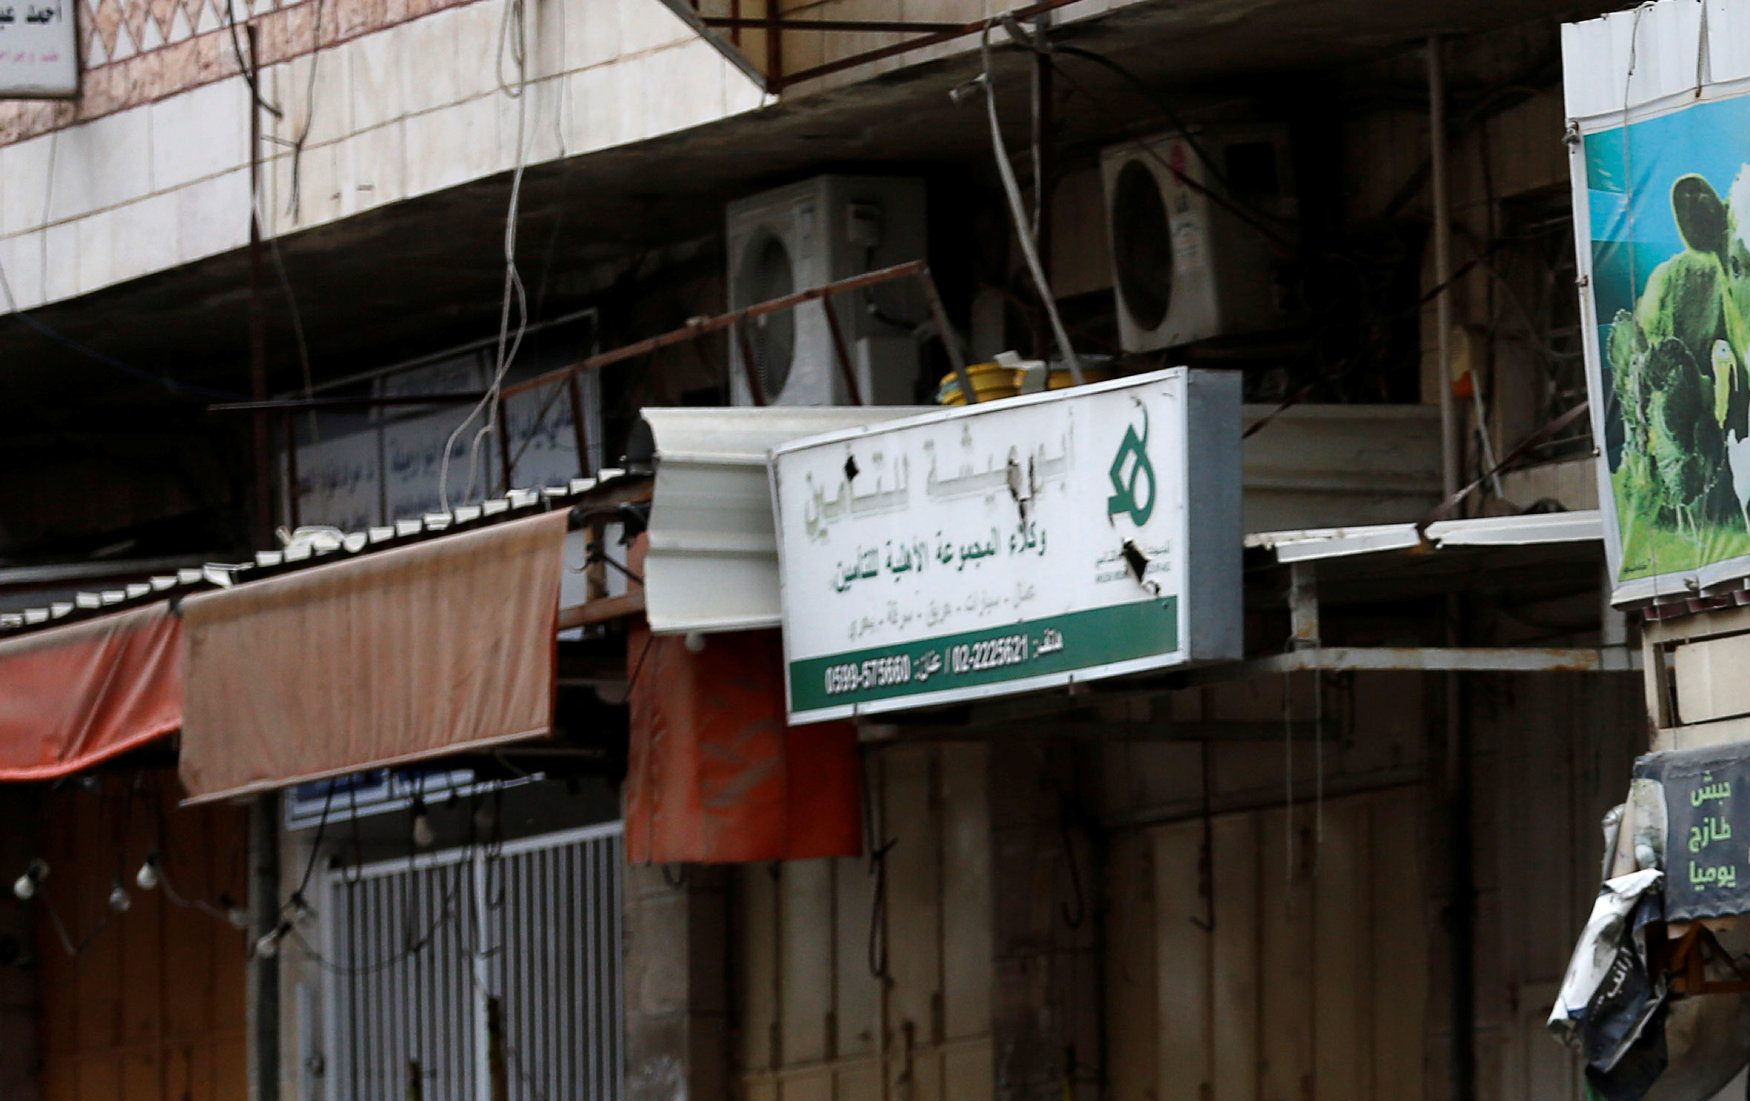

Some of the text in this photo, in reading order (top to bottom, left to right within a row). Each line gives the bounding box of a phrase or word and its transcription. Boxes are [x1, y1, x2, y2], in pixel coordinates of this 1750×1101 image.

[935, 527, 1000, 572] المجموعة
[952, 633, 1029, 674] 02-2225621
[1690, 769, 1731, 807] حبش
[1688, 816, 1732, 854] طازج
[1689, 860, 1737, 891] يوميا
